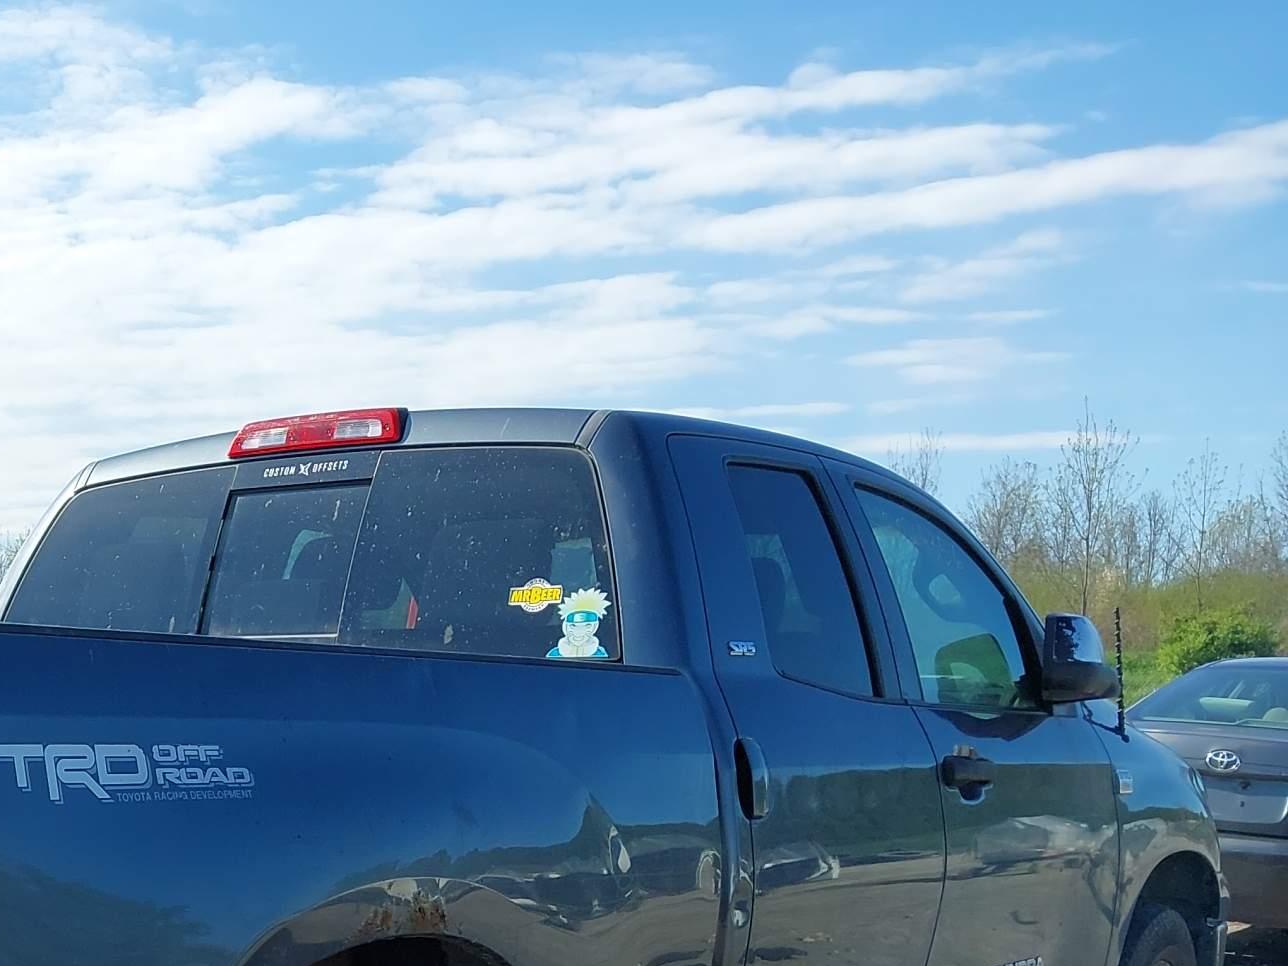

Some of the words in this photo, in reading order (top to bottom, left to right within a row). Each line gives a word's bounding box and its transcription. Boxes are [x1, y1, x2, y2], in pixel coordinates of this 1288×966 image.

[263, 466, 296, 478] CUSTOM
[312, 459, 349, 473] OFFSETS
[152, 744, 224, 765] OFF
[155, 767, 256, 789] ROAD
[116, 791, 152, 803] TOYOTA
[154, 790, 188, 801] RACING
[190, 789, 253, 801] DEVELOPMENT
